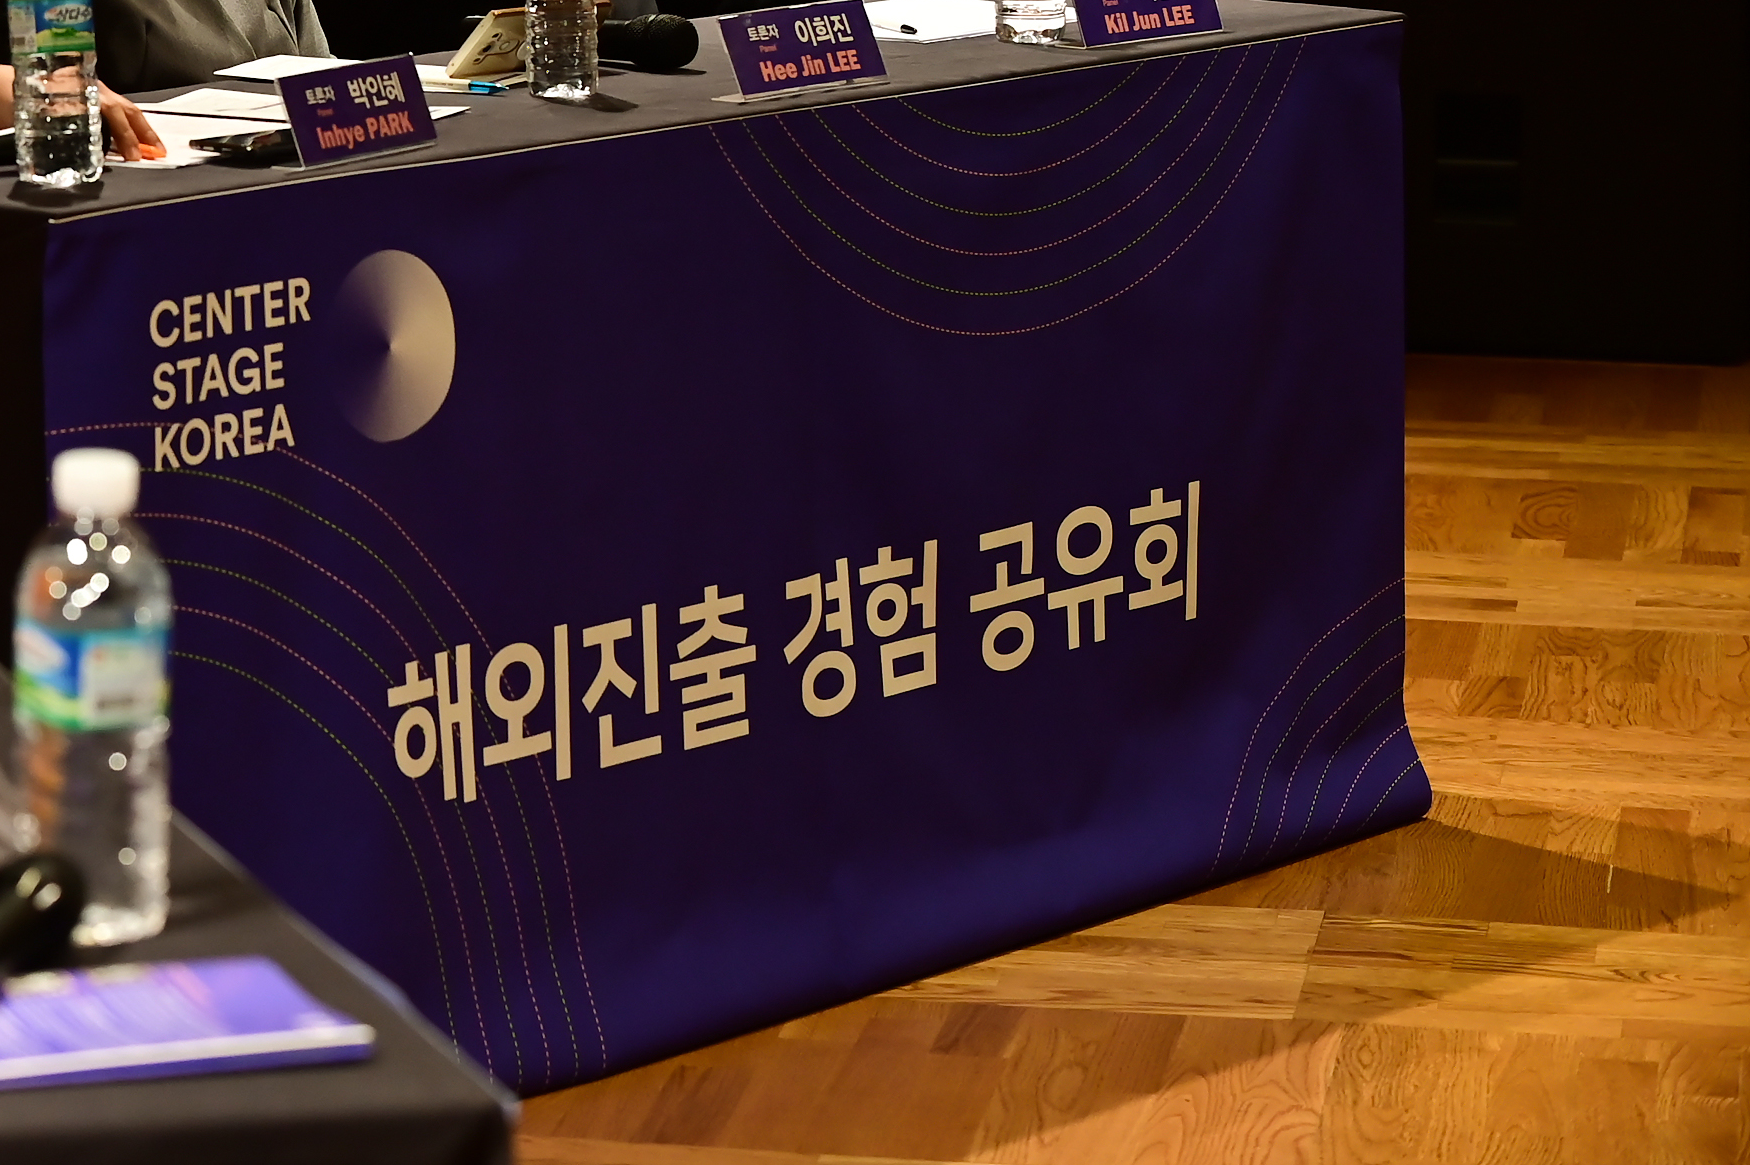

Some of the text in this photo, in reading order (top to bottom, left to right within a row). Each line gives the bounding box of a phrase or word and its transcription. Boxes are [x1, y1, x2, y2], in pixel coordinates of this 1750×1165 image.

[747, 13, 854, 47] 토론자 이희진
[1104, 4, 1195, 34] Kil Jun LEE
[759, 49, 862, 82] Hee Jin LEE
[347, 71, 406, 109] 박인혜
[316, 110, 415, 150] Inhye PARK
[149, 276, 311, 348] CENTER
[151, 342, 285, 410] STAGE
[154, 403, 295, 473] KOREA
[387, 583, 756, 804] 해외진출
[783, 539, 938, 718] 경험
[970, 480, 1201, 672] 공유회
